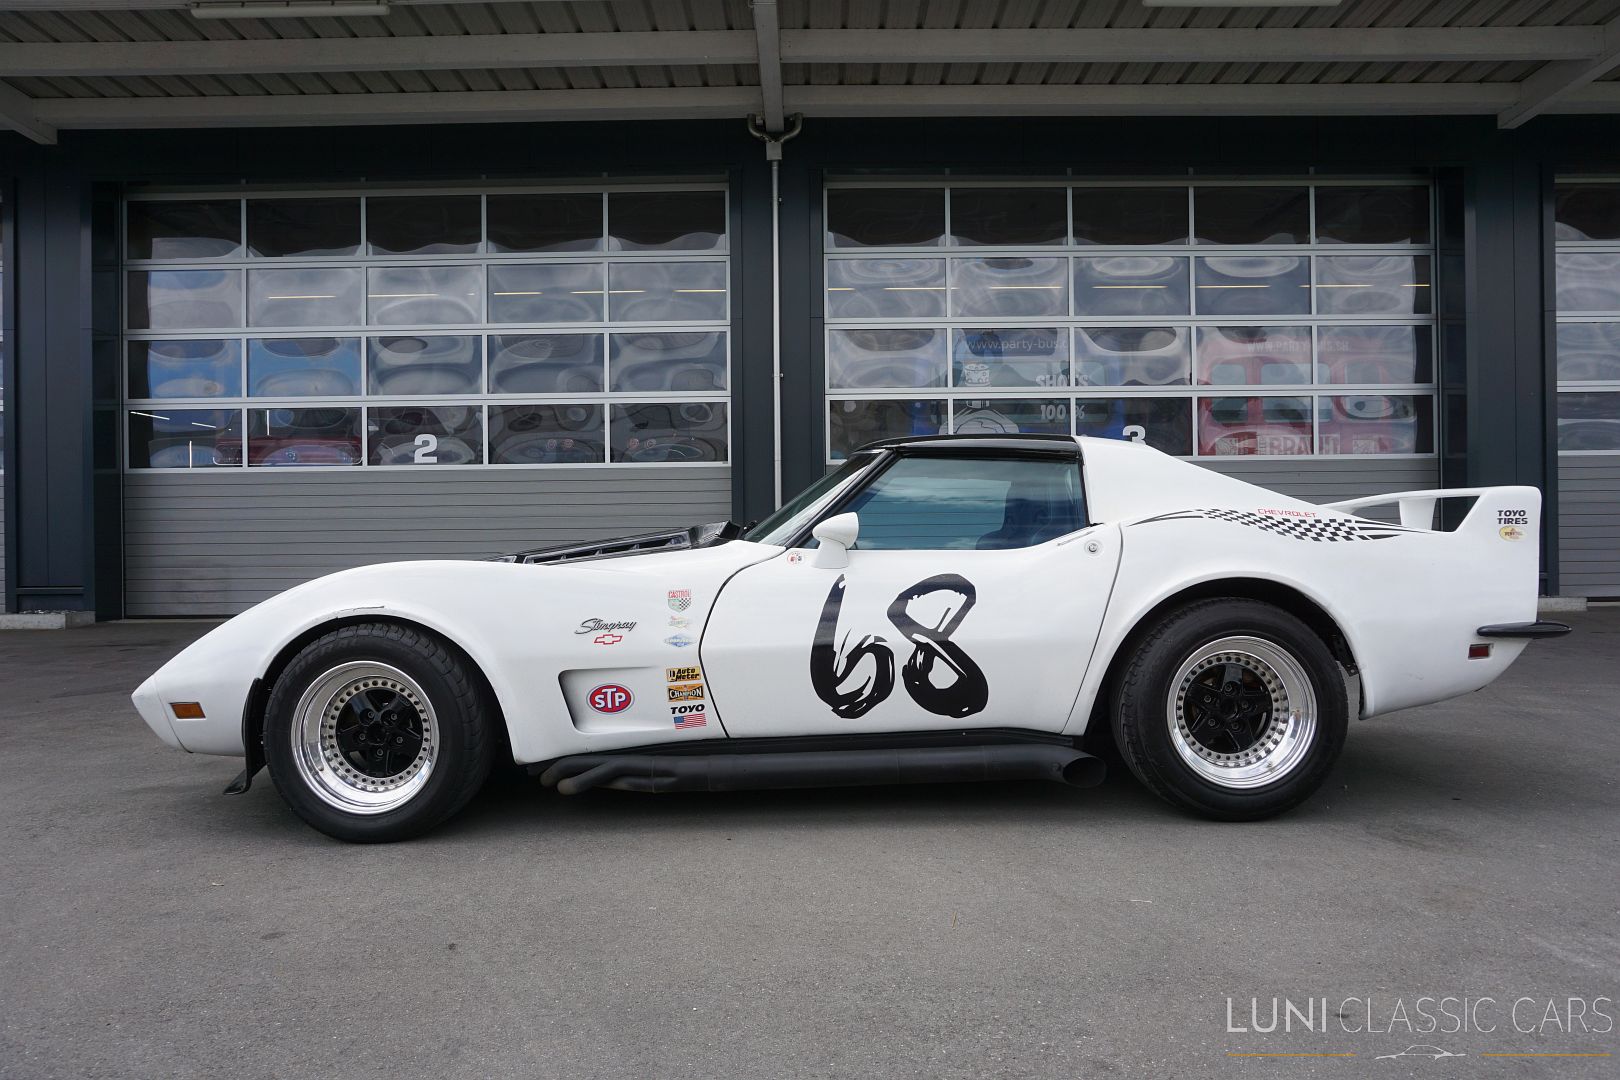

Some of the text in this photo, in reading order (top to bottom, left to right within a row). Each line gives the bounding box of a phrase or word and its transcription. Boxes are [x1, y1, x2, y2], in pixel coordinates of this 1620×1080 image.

[1122, 424, 1147, 445] 3
[414, 433, 438, 463] 2
[1257, 508, 1317, 518] CHEVROLET
[1496, 509, 1527, 517] TOYO
[1496, 517, 1529, 525] TIRES
[667, 589, 692, 599] CASTROL
[574, 617, 638, 634] Stingray
[810, 573, 989, 719] 68
[676, 667, 696, 675] Auto
[675, 673, 700, 681] Meter
[594, 687, 627, 709] STP
[670, 703, 705, 715] TOYO
